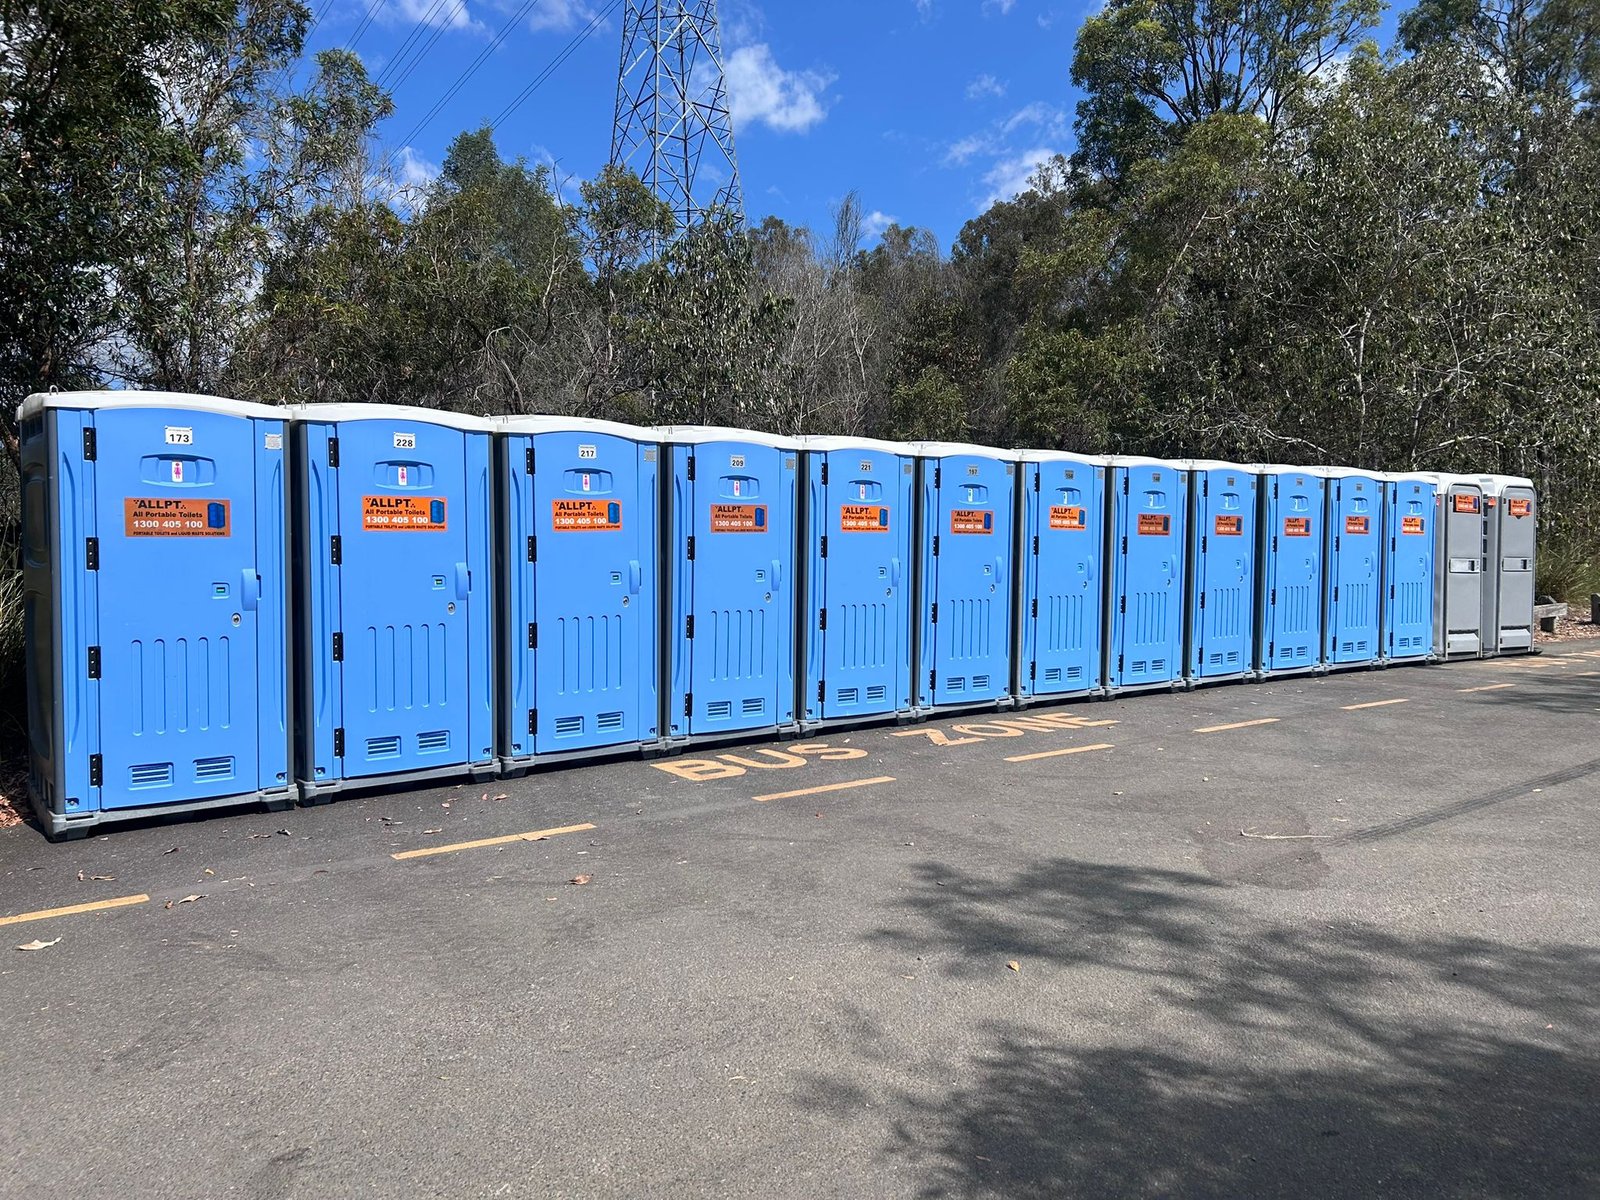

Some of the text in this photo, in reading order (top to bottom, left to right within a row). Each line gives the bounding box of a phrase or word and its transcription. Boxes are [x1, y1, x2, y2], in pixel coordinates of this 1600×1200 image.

[169, 433, 190, 443] 173
[396, 438, 413, 447] 228
[580, 450, 595, 458] 217
[731, 459, 744, 467] 209
[133, 520, 203, 528] 1300 405 100
[555, 517, 607, 525] 1300 405 100
[649, 711, 1120, 782] BUS ZONE
